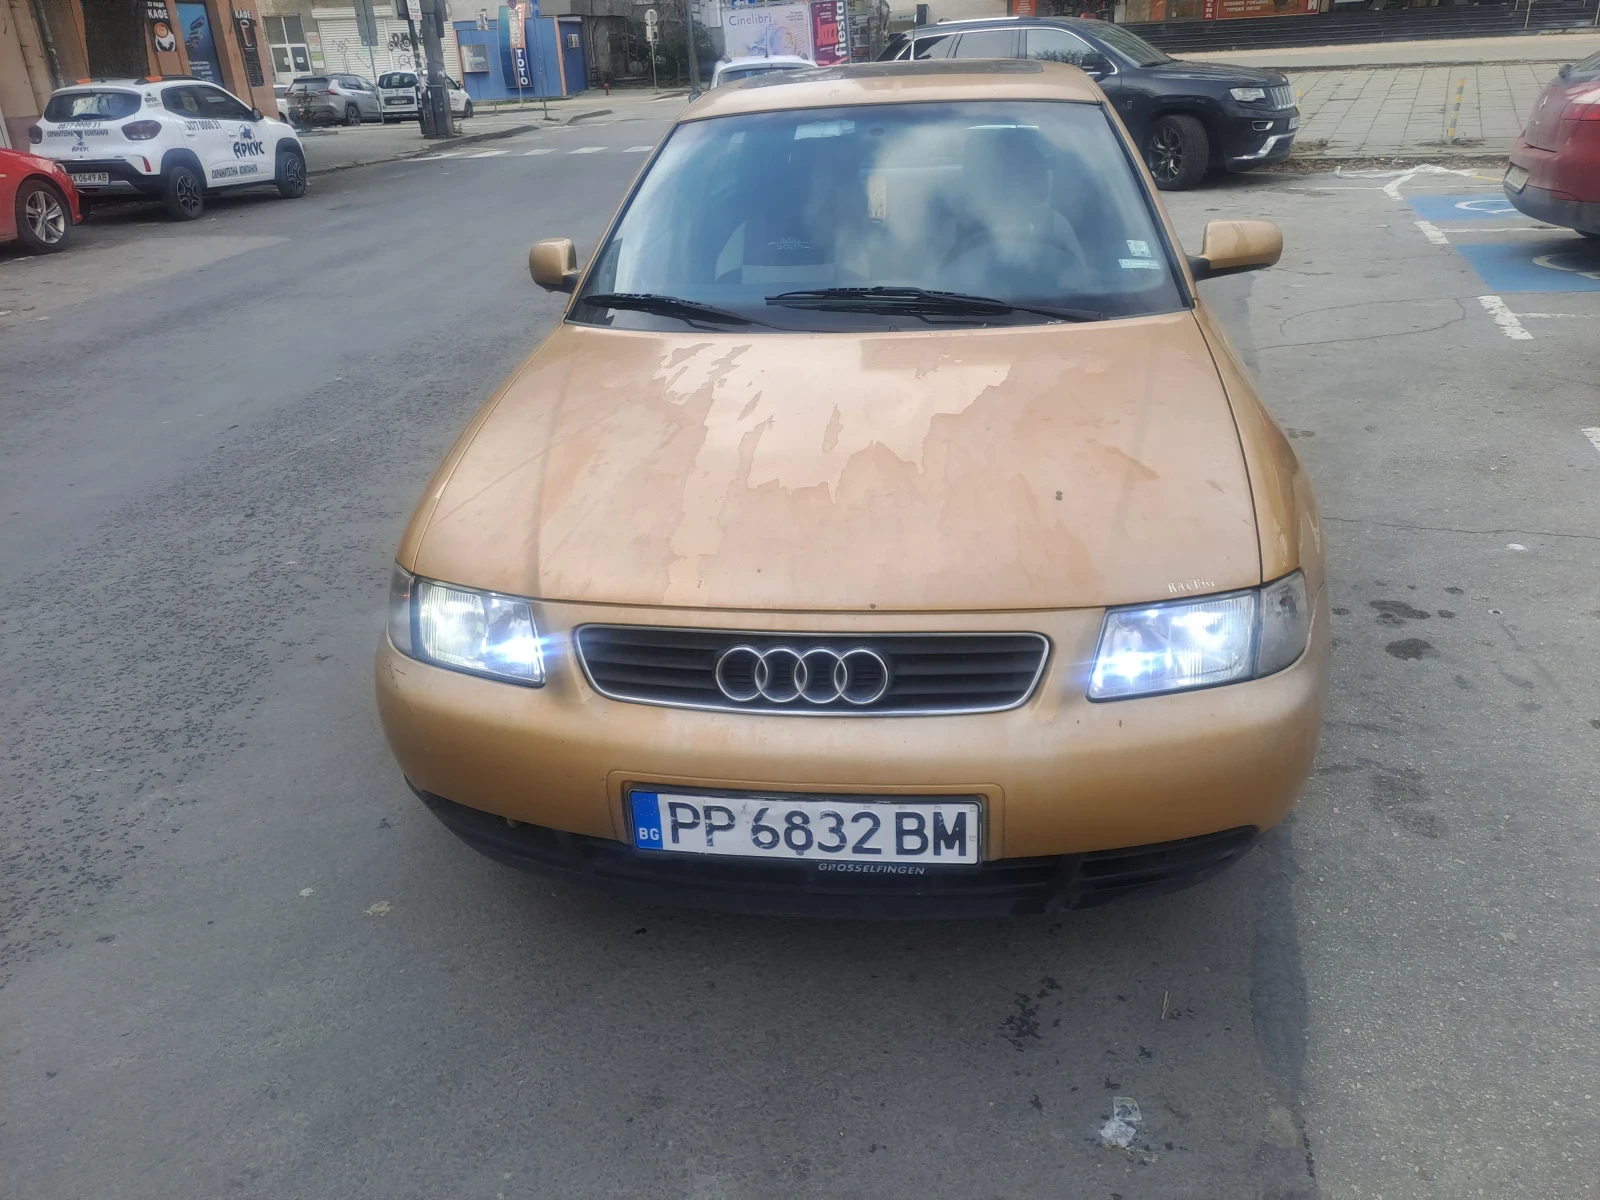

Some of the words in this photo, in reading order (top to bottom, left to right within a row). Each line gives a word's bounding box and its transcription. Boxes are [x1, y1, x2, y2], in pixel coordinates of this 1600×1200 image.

[147, 8, 169, 19] КАФЕ
[234, 9, 252, 19] КАФЕ
[728, 12, 772, 26] Cinelibri
[835, 2, 847, 57] fiesta
[57, 122, 74, 130] 0877
[233, 141, 265, 160] АРКУС
[78, 173, 96, 183] 0649
[97, 173, 108, 182] AB
[638, 826, 660, 841] BG
[667, 801, 736, 847] PP
[751, 807, 883, 857] 6832
[894, 811, 967, 857] BM
[817, 862, 926, 876] GROSSELFINGEN
